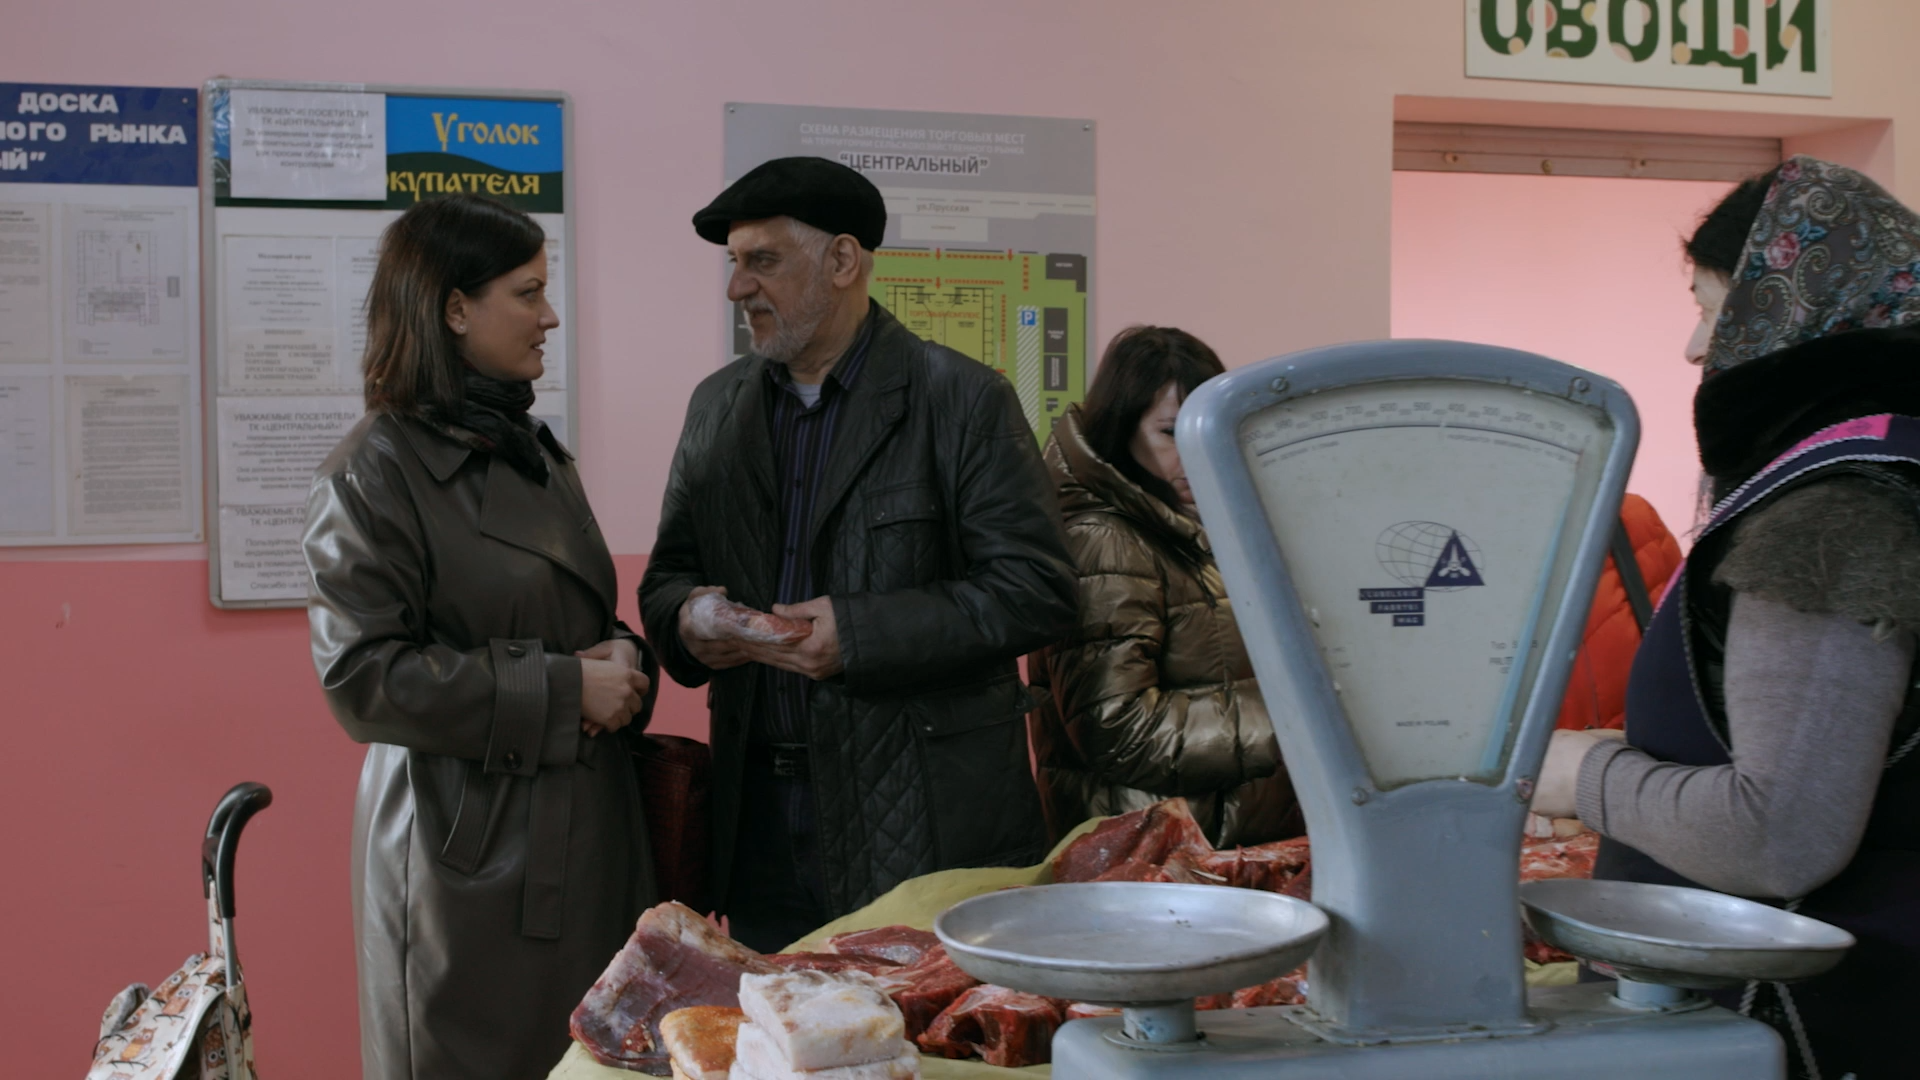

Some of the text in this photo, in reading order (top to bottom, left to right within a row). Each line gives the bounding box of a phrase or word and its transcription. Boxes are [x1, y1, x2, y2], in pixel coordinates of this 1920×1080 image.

[1480, 0, 1816, 84] ОВОЩИ
[18, 92, 119, 114] ДОСКА
[90, 123, 187, 144] РЫНКА
[800, 123, 1026, 144] СХЕМА РАЗМЕЩЕНИЯ ТОРГОВЫХ МЕСТ
[233, 412, 356, 422] УВАЖАЕМЫЕ ПОСЕТИТЕЛИ
[248, 423, 259, 432] ТК
[235, 508, 294, 516] УВАЖАЕМЫЕ
[250, 517, 305, 526] ТК «ЦЕНТРА
